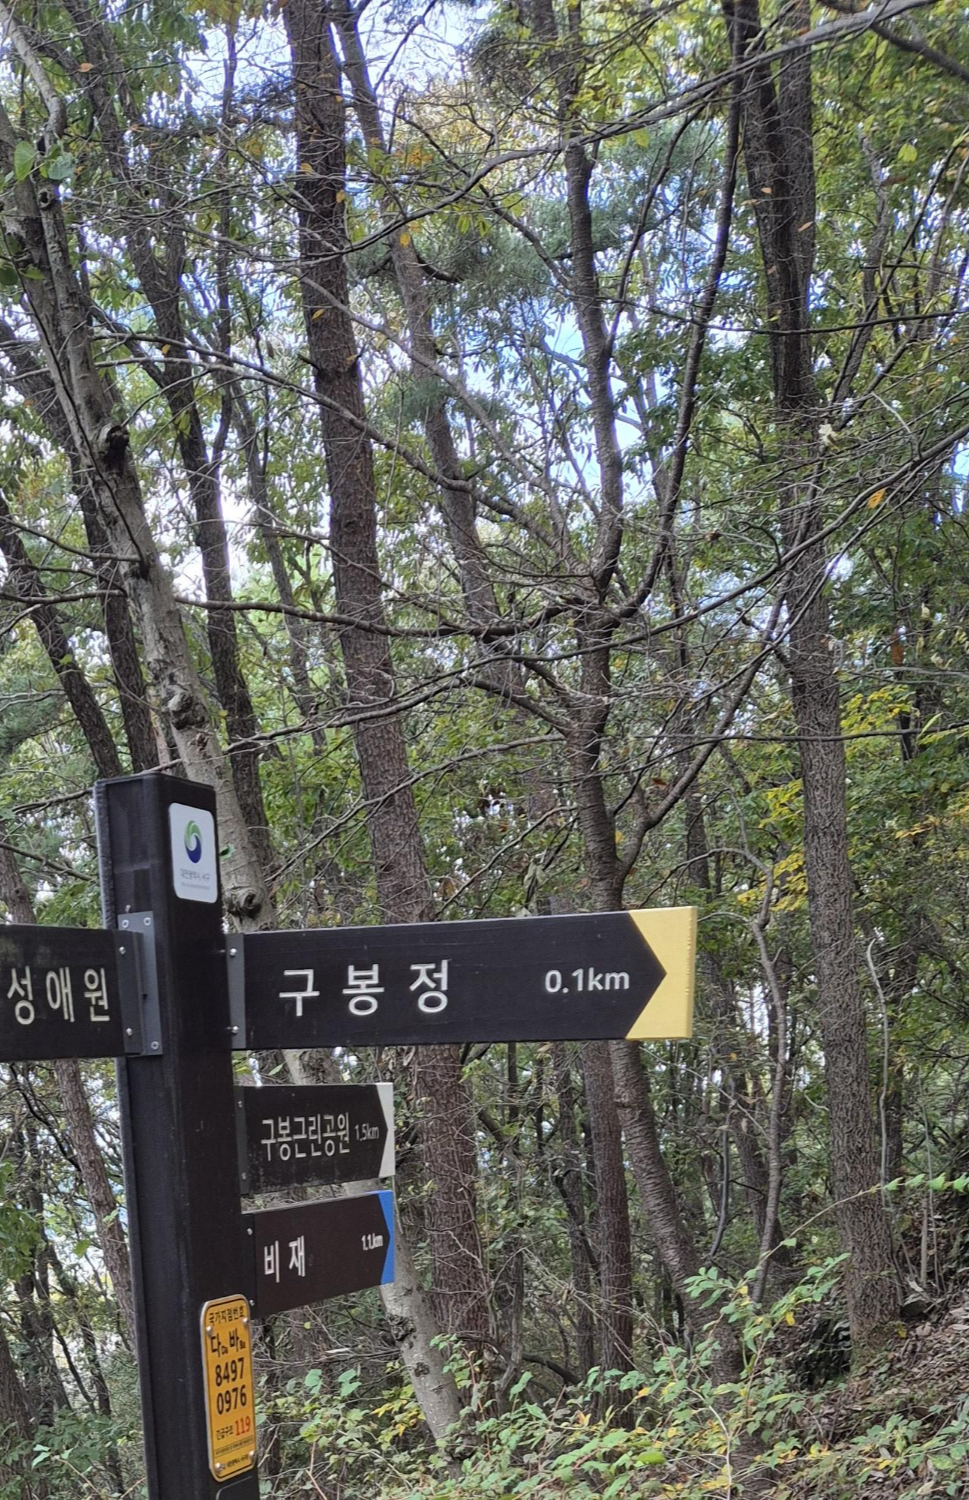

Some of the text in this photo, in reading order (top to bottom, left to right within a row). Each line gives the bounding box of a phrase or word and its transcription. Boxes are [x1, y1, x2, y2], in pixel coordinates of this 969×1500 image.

[6, 965, 111, 1026] 성애원
[278, 958, 631, 1018] 구봉정 0.1km
[260, 1111, 380, 1163] 구봉근린공원 1.5km
[215, 1356, 245, 1388] 8497
[216, 1384, 247, 1416] 0976
[234, 1415, 252, 1437] 119
